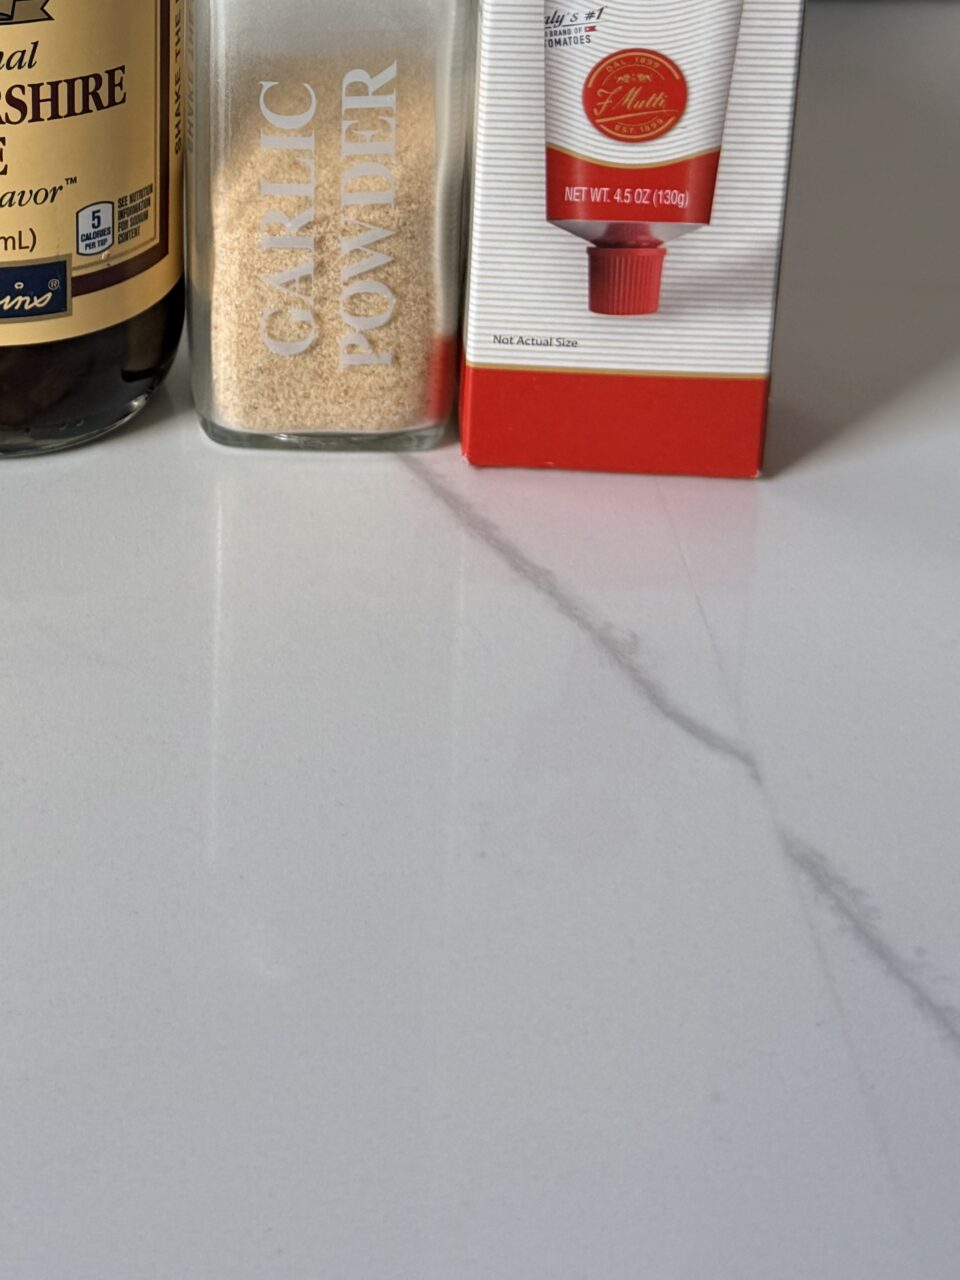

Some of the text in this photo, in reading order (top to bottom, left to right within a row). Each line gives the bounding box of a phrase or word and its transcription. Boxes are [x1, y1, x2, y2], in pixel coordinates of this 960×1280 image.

[564, 186, 689, 208] NET WT. 4.5 OZ (130g)
[91, 209, 101, 229] 5
[259, 80, 317, 358] GARLIC
[340, 59, 398, 369] POWDER
[493, 334, 578, 348] Not Actual Size
